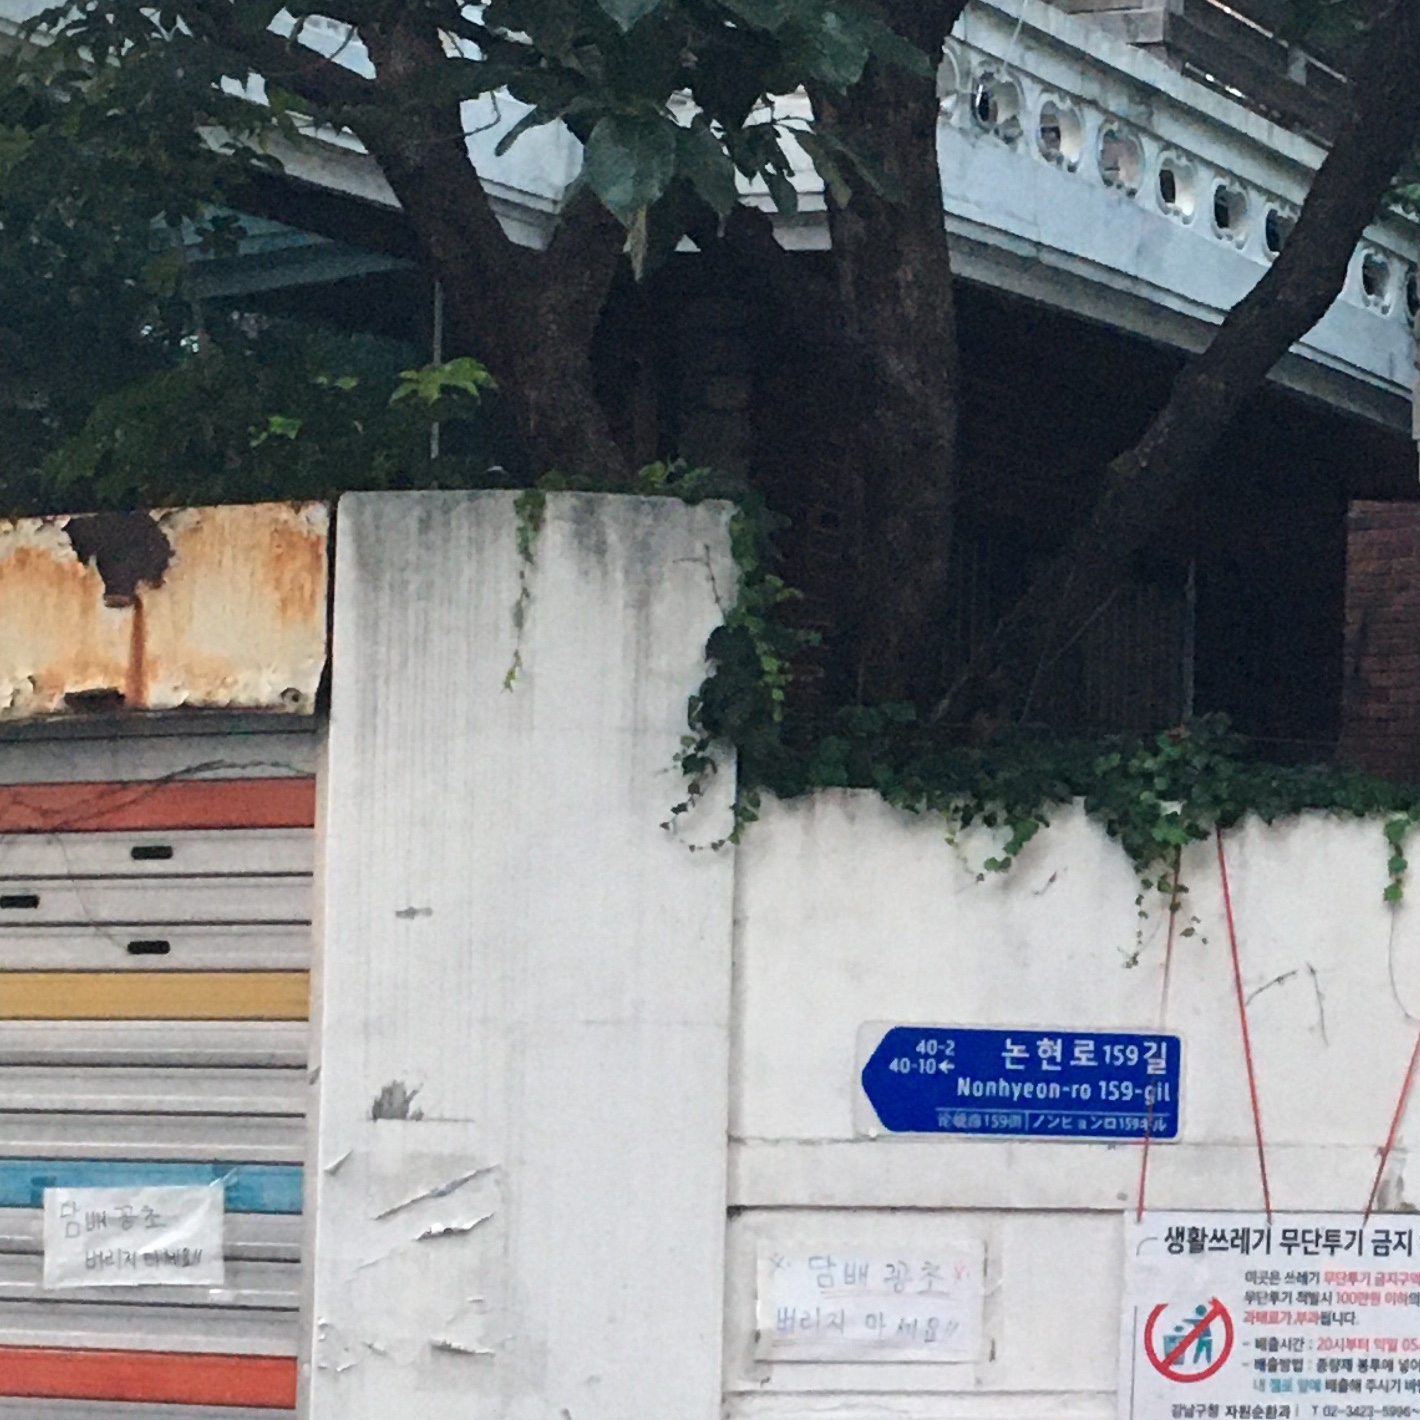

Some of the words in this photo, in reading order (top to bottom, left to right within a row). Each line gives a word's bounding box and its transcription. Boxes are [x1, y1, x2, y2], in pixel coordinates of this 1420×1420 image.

[916, 1039, 955, 1056] 40-2
[888, 1057, 937, 1074] 40-10
[957, 1077, 1092, 1101] Nonhyeon-ro
[1098, 1080, 1171, 1106] 159-gil
[1164, 1226, 1272, 1255] 생활쓰레기
[1279, 1228, 1363, 1256] 무단투기
[1371, 1229, 1413, 1257] 금지
[1284, 1270, 1320, 1286] 쓰레기
[1324, 1271, 1371, 1286] 무단투기
[1245, 1290, 1292, 1305] 무단투기
[777, 1306, 845, 1335] 버리지
[1317, 1337, 1369, 1352] 20시부터
[1365, 1378, 1401, 1394] 주시기
[1172, 1403, 1219, 1419] 강남구청
[1225, 1404, 1291, 1420] 자원순환과
